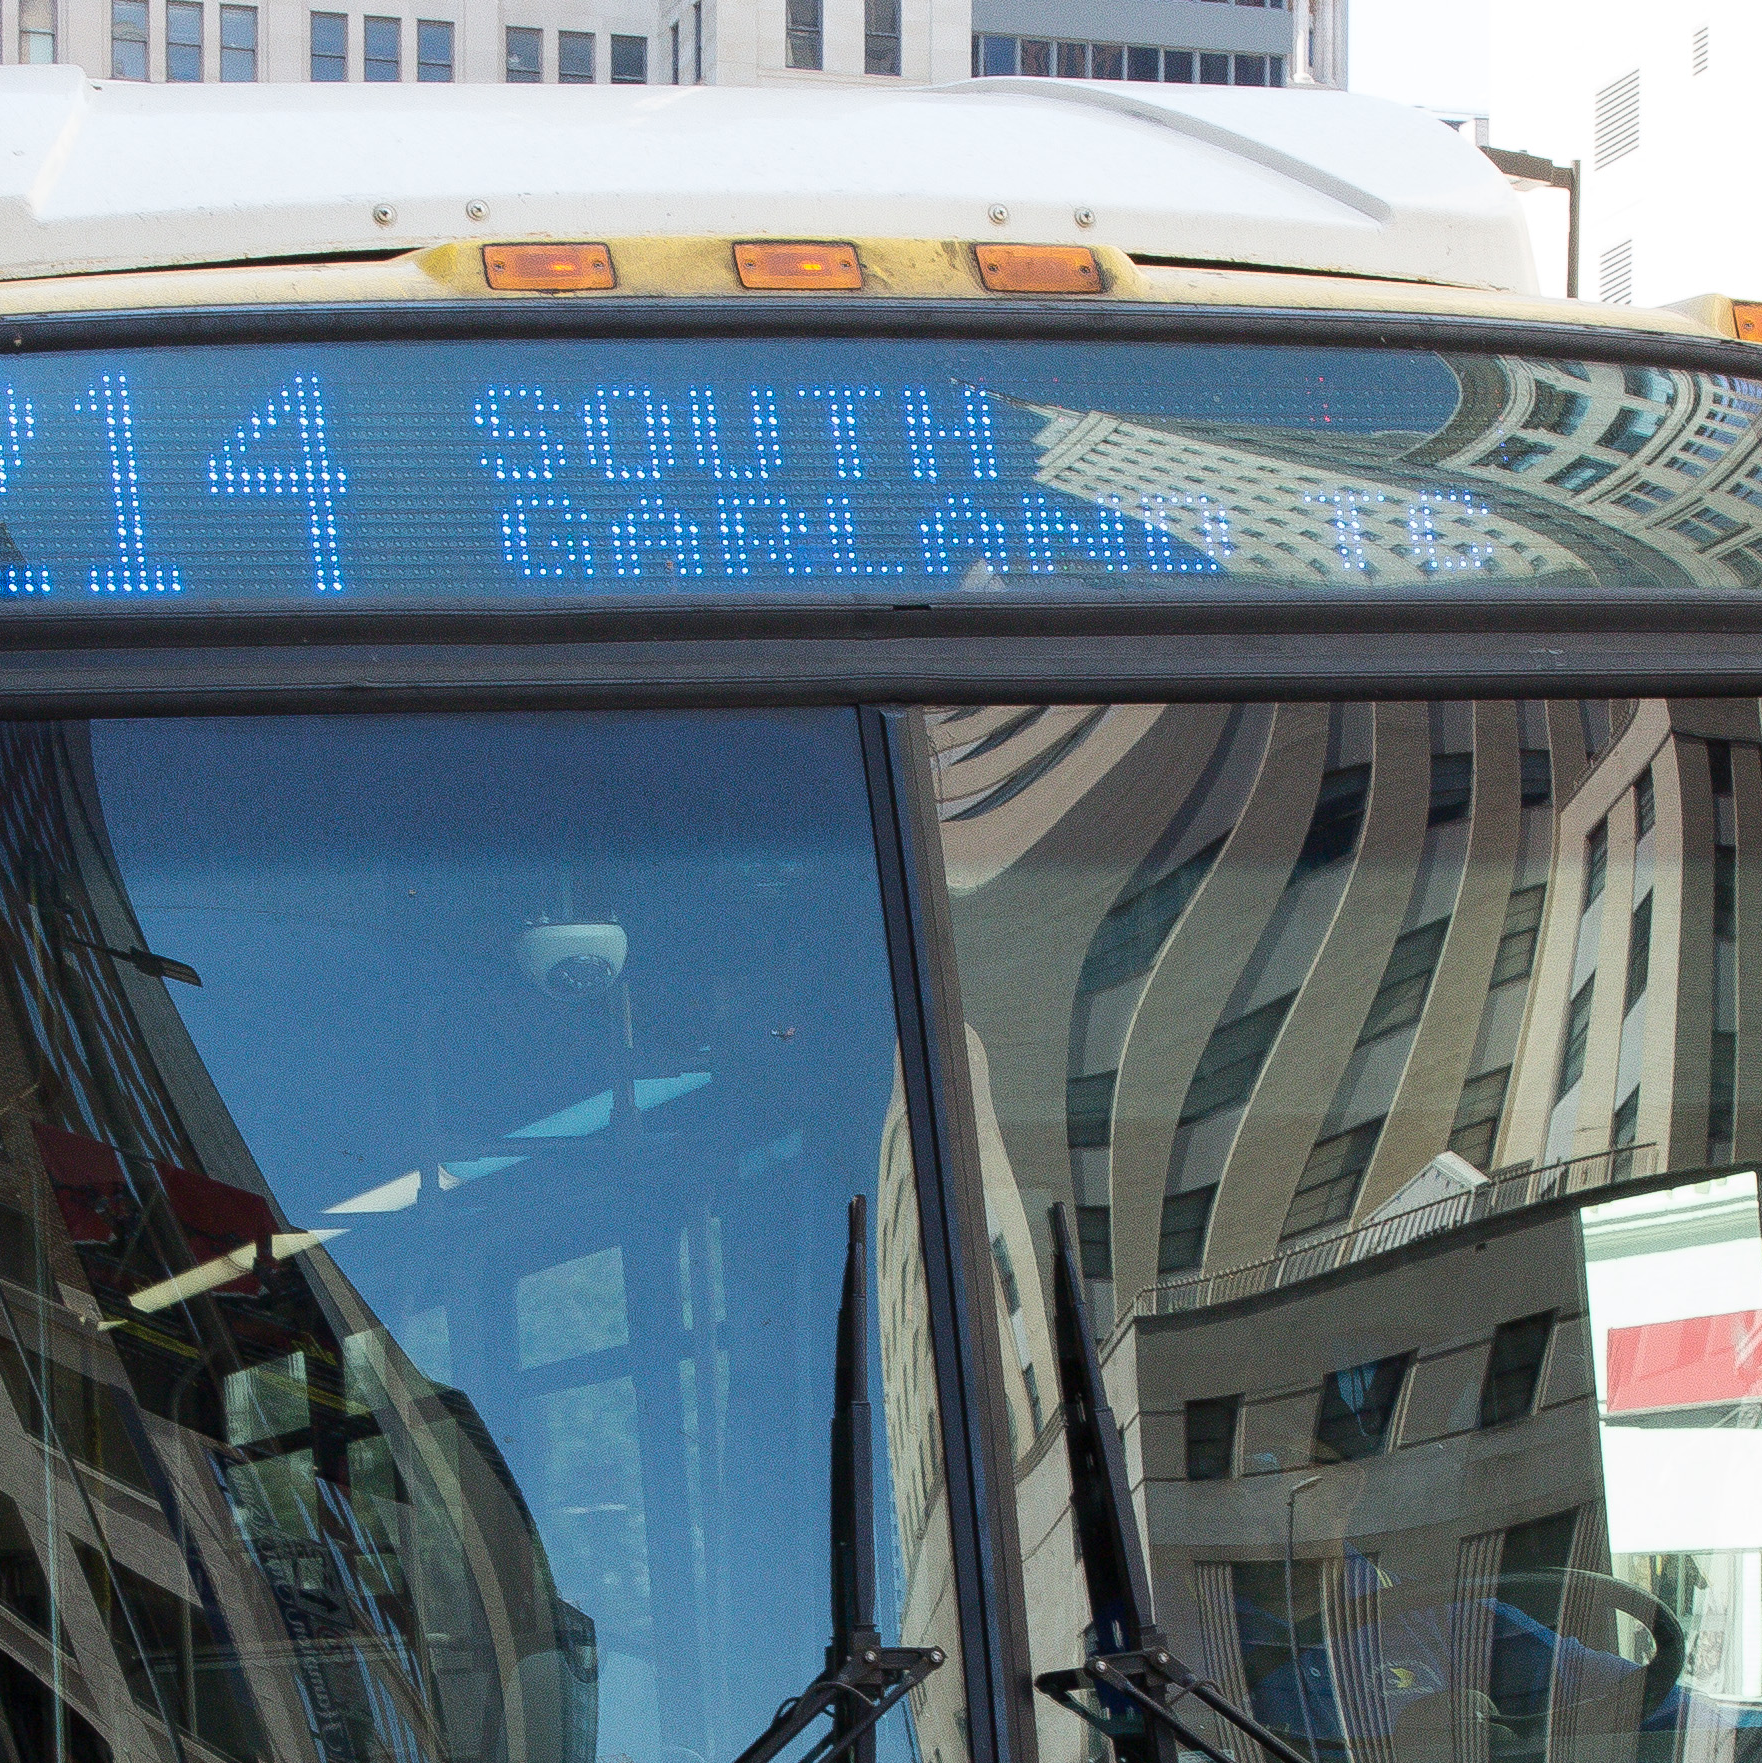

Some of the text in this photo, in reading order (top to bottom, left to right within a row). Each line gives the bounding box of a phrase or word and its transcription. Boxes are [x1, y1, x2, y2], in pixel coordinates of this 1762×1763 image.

[474, 386, 998, 480] SOUTH
[500, 493, 1492, 577] GARLAND TC
